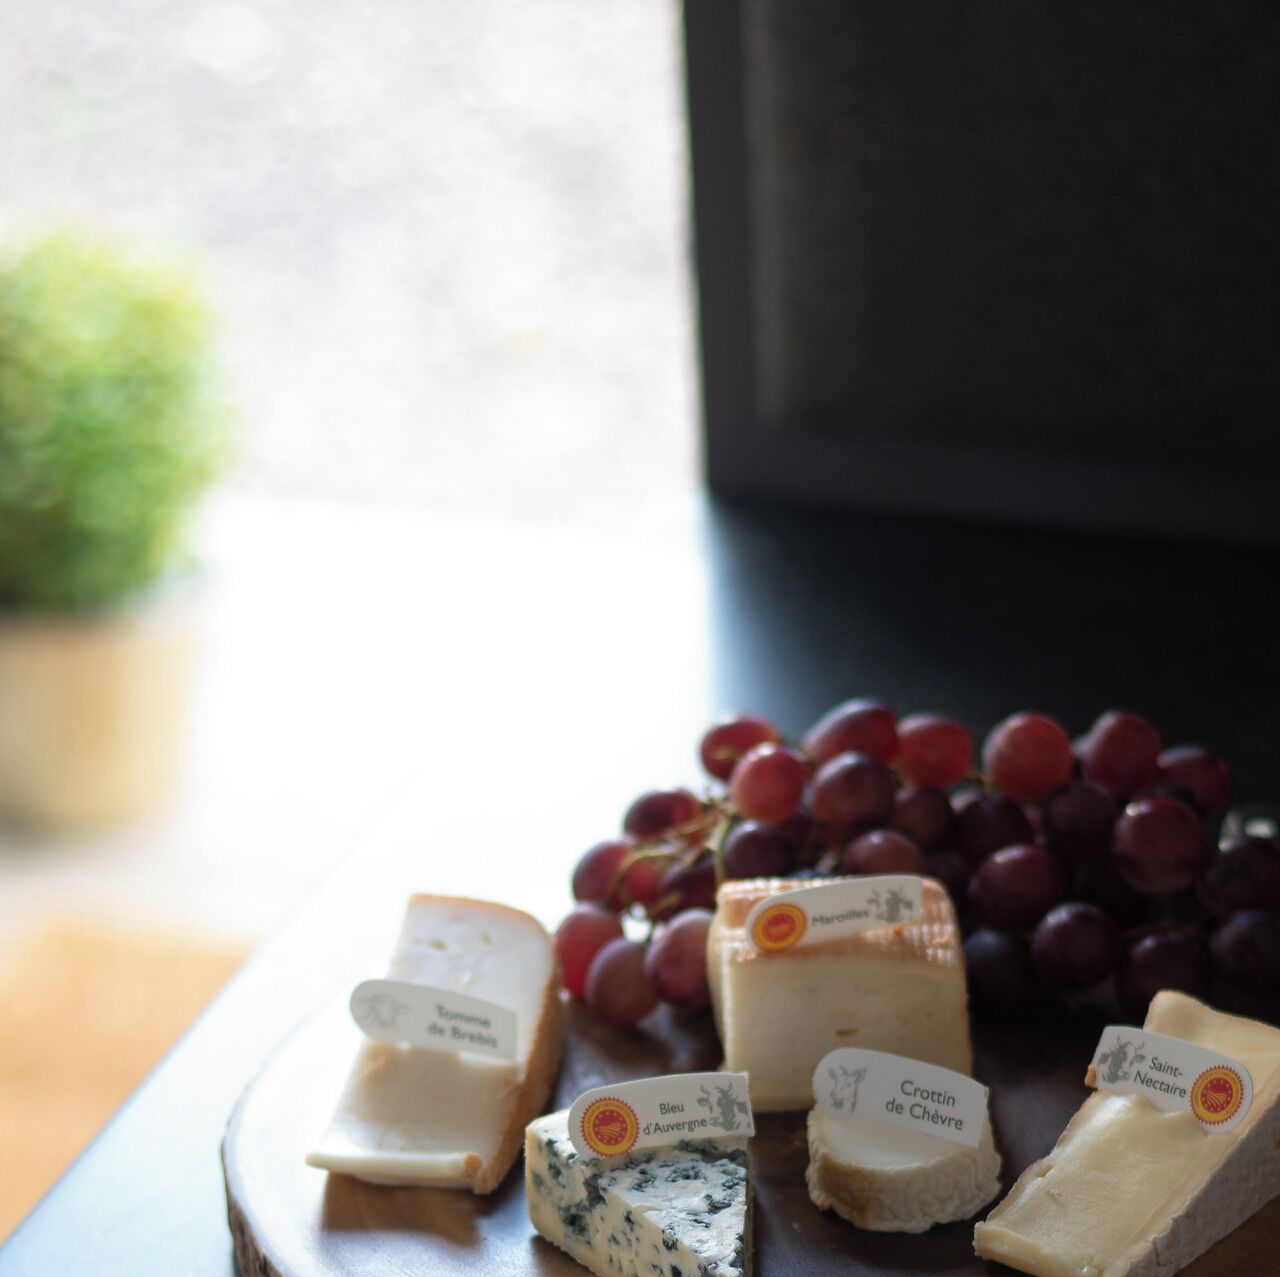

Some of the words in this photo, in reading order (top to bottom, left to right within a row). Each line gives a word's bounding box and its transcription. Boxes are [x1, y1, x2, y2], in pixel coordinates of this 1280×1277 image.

[812, 908, 870, 927] Maroilles
[435, 1004, 491, 1028] Tomme
[427, 1022, 446, 1037] de
[451, 1026, 498, 1048] Brebis
[1148, 1056, 1183, 1078] Saint-
[900, 1080, 956, 1108] Crottin
[1133, 1070, 1187, 1099] Nectaire
[659, 1102, 685, 1116] Bleu
[885, 1098, 904, 1114] de
[909, 1103, 964, 1131] Chèvre
[643, 1117, 707, 1136] d'Auvergne
